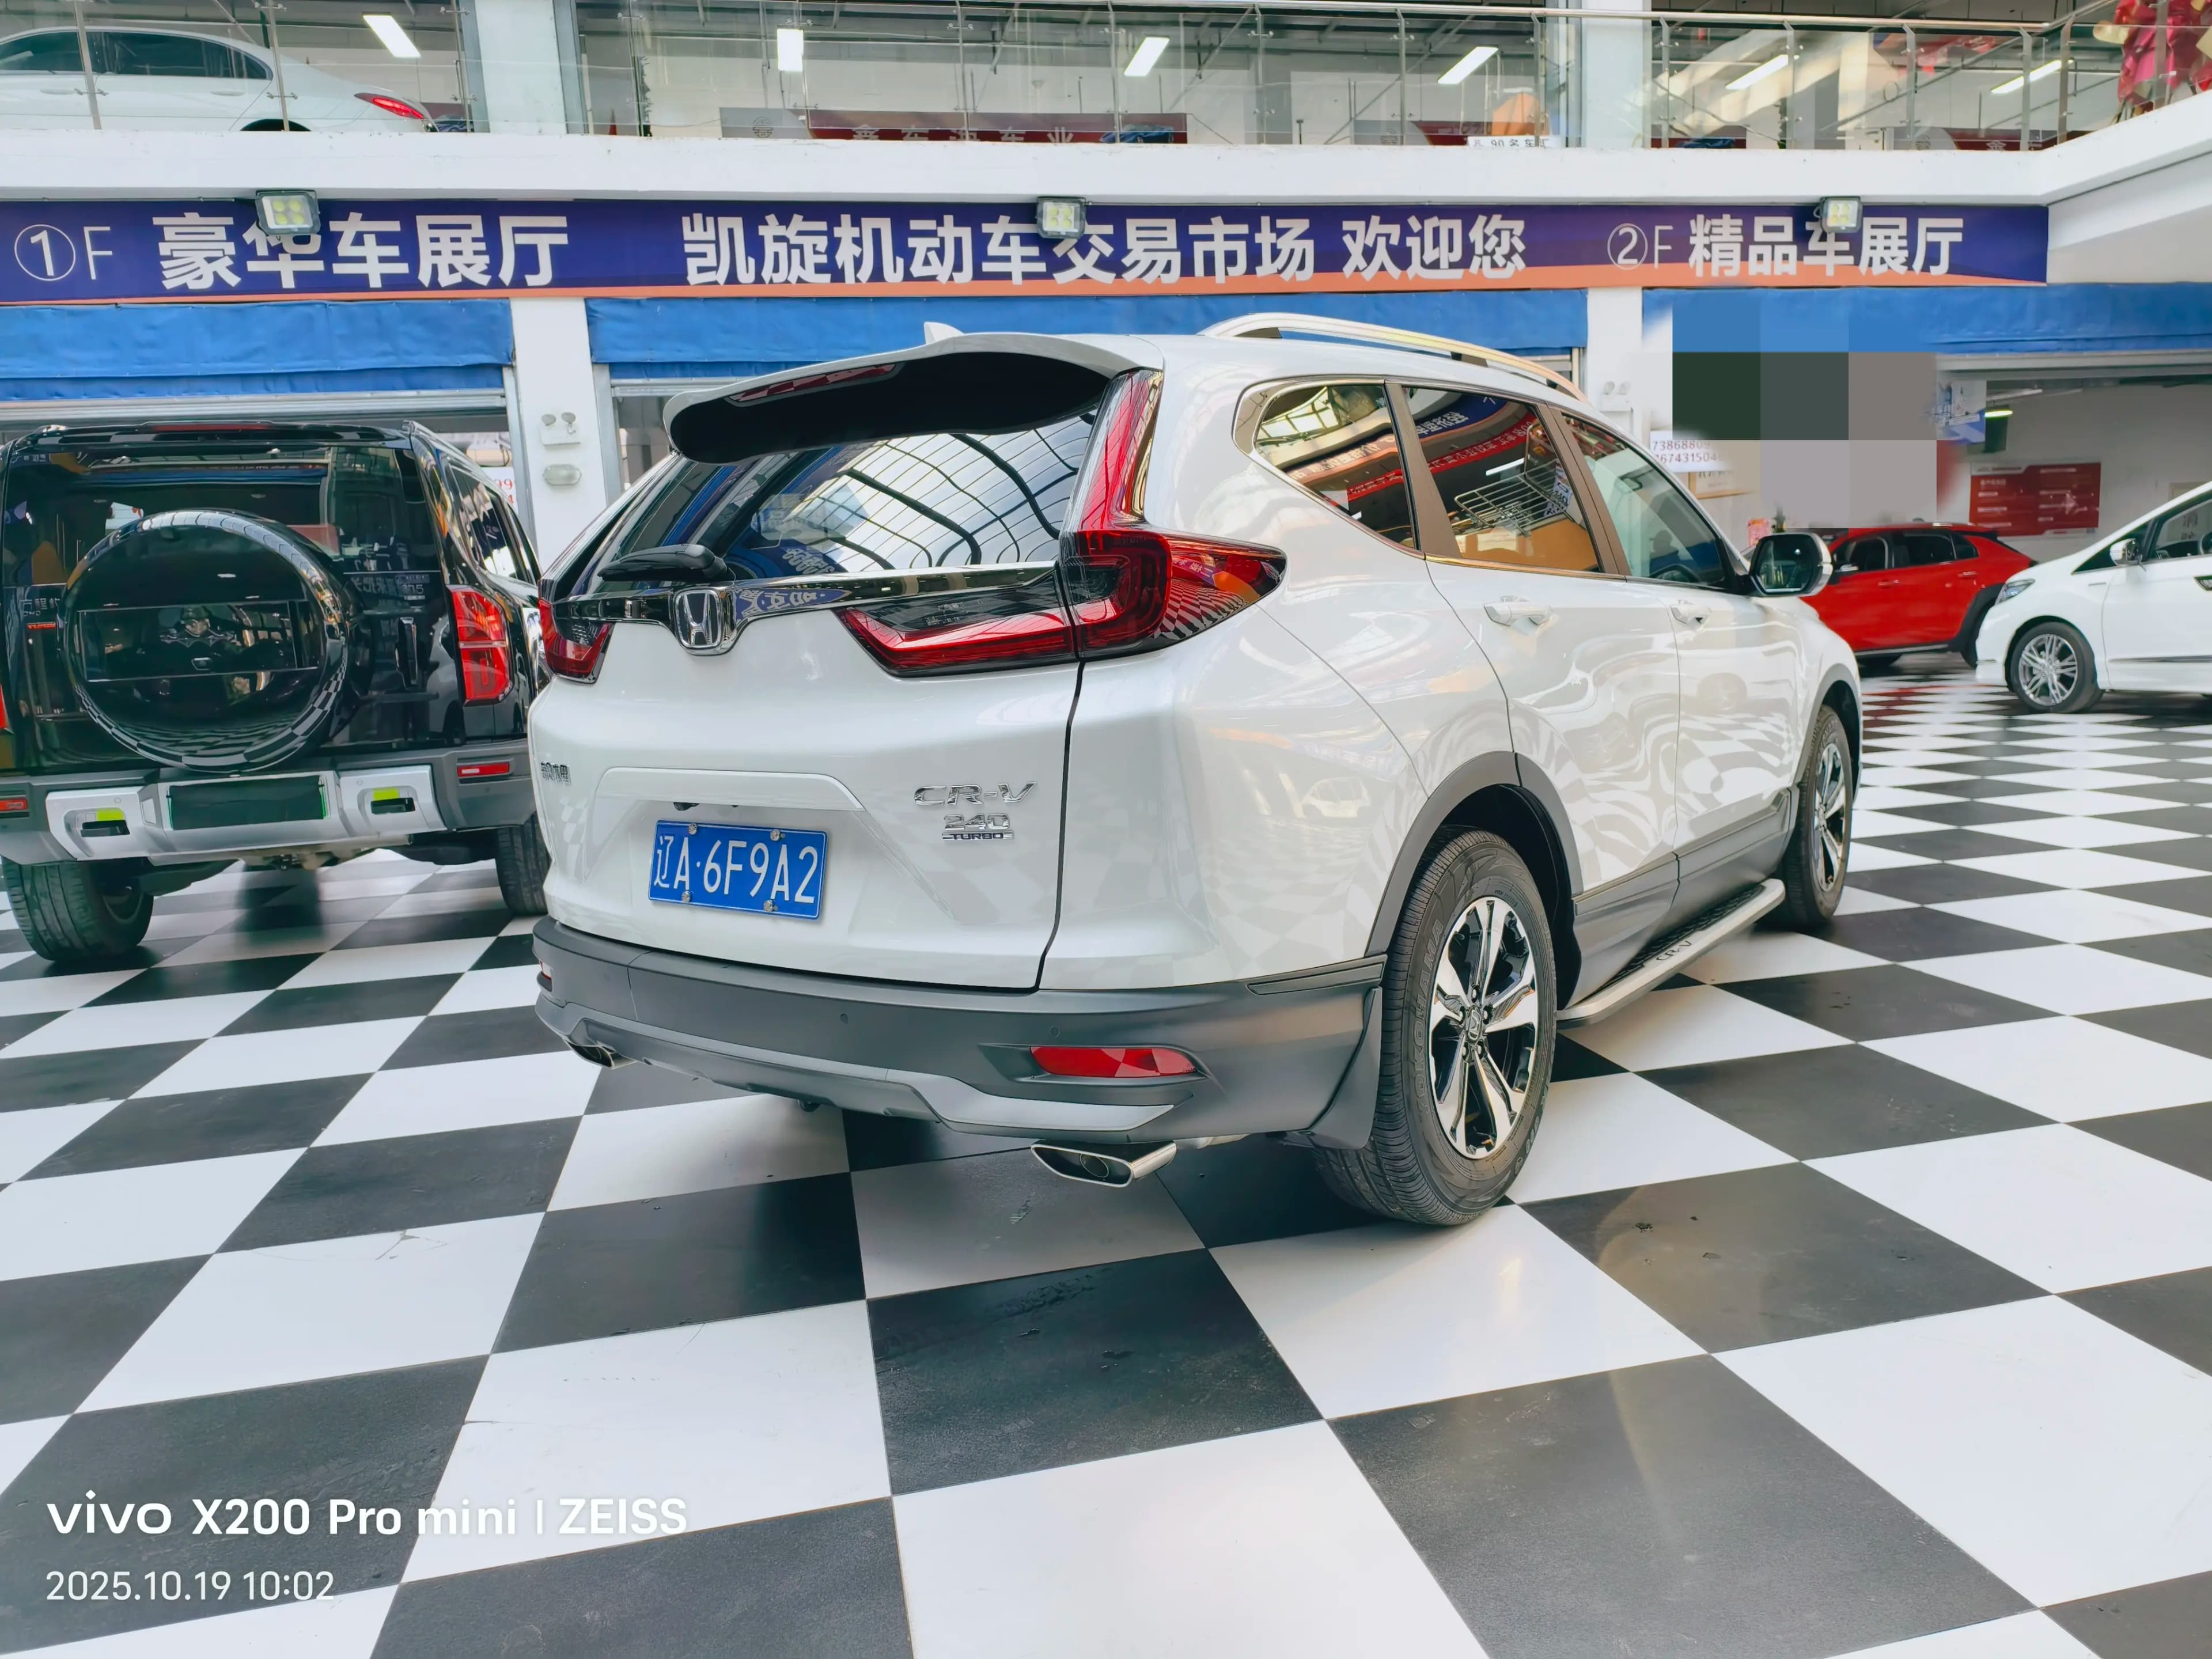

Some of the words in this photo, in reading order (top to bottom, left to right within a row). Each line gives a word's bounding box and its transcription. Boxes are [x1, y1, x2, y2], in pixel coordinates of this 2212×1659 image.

[152, 212, 569, 290] 豪华车展厅
[681, 213, 1315, 285] 凯旋机动车交易市场
[1342, 214, 1527, 282] 欢迎您
[1688, 213, 1964, 278] 精品车展厅
[914, 781, 1037, 806] CR-V
[943, 813, 1010, 831] 240
[949, 832, 1005, 840] TURBO
